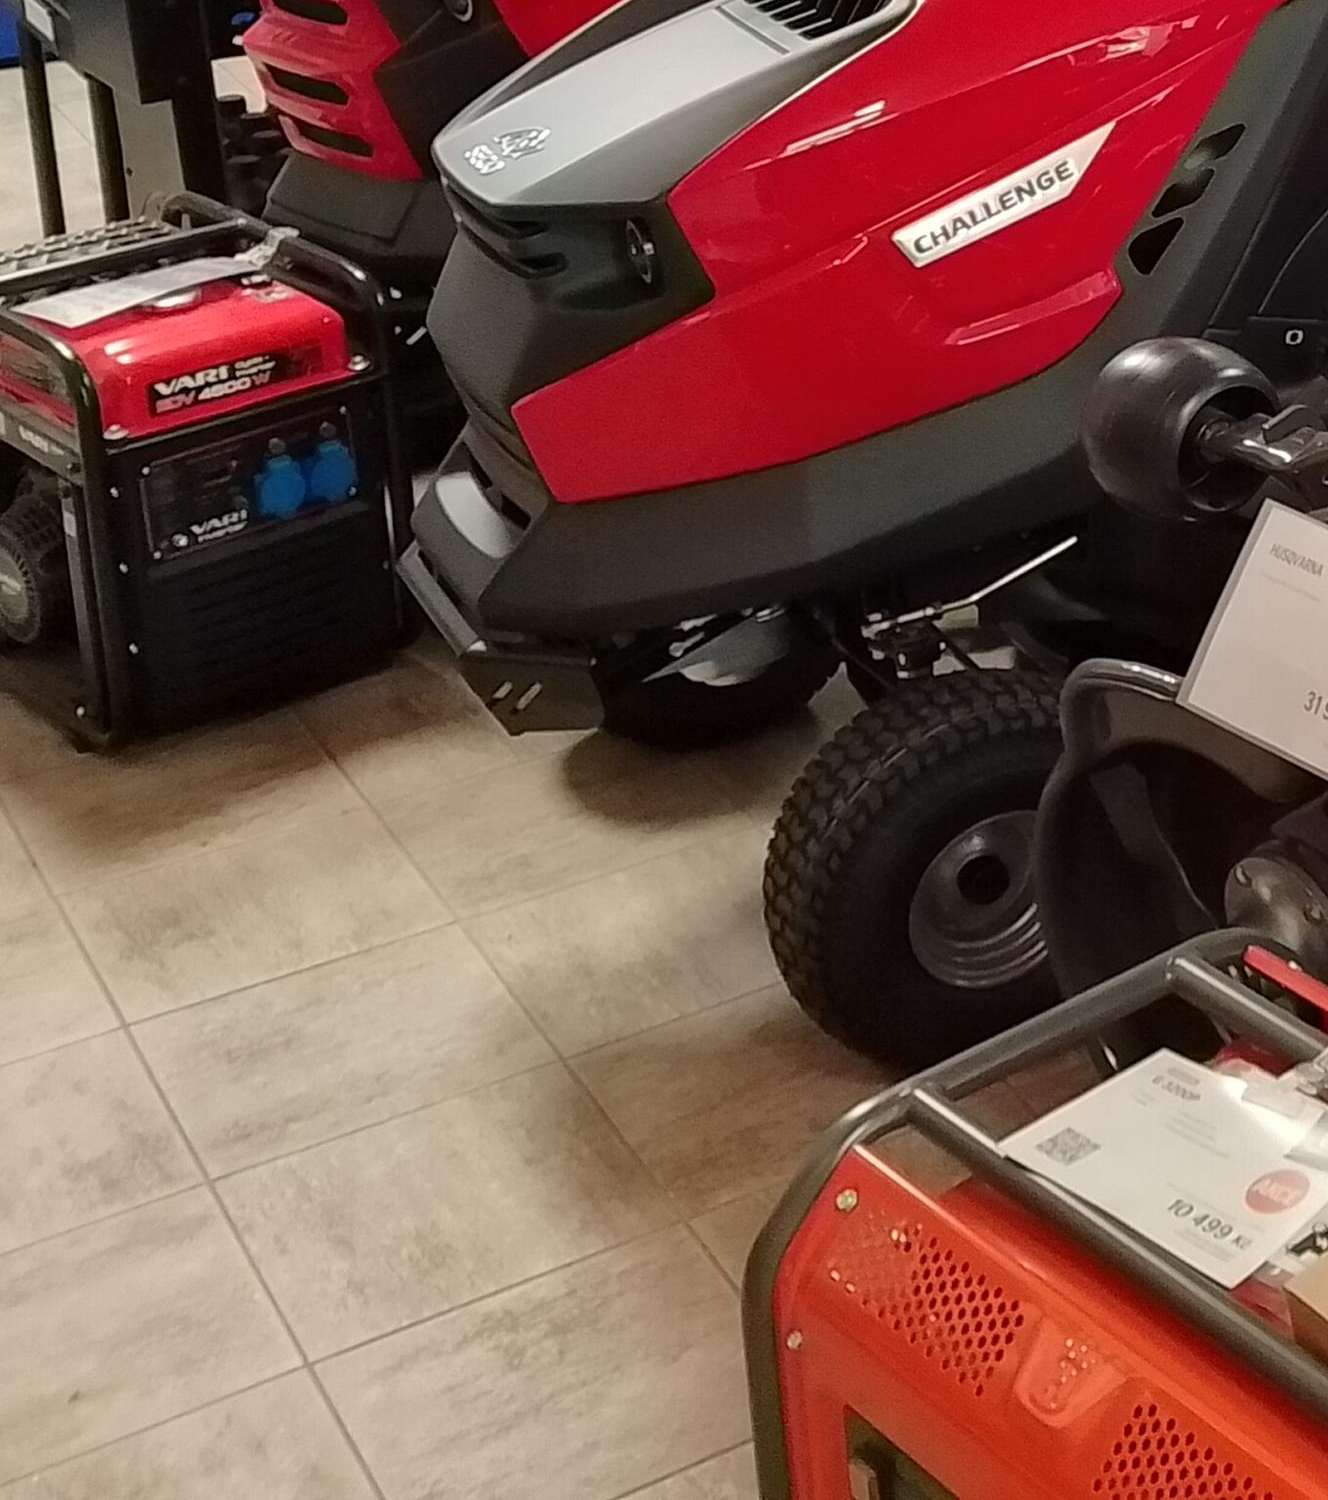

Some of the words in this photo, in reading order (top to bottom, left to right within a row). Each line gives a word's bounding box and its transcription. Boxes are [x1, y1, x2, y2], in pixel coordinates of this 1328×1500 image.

[912, 158, 1076, 256] CHALLENGE
[153, 365, 230, 396] VARI
[189, 508, 248, 535] VARI
[1269, 542, 1324, 578] HUSQVARNA
[1166, 1198, 1194, 1219] 10
[1192, 1206, 1234, 1240] 499
